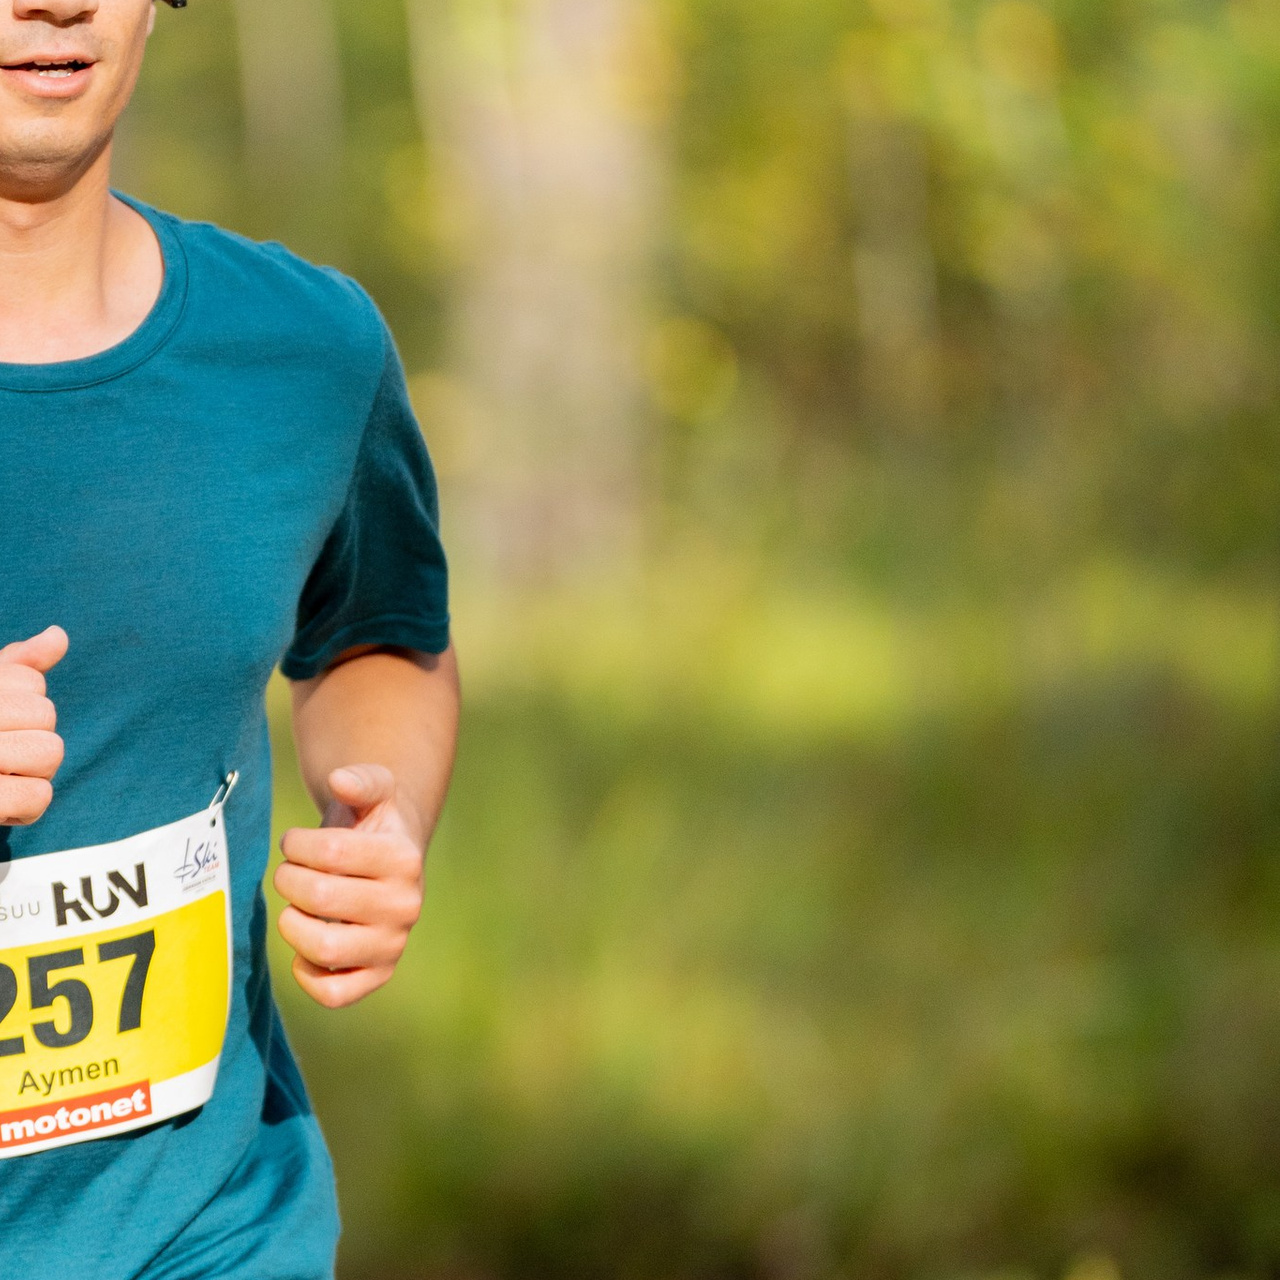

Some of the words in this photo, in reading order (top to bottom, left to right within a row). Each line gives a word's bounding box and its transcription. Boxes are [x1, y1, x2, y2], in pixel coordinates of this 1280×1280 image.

[51, 861, 149, 927] RUN
[18, 1056, 120, 1097] Aymen
[0, 1087, 147, 1143] motonet
